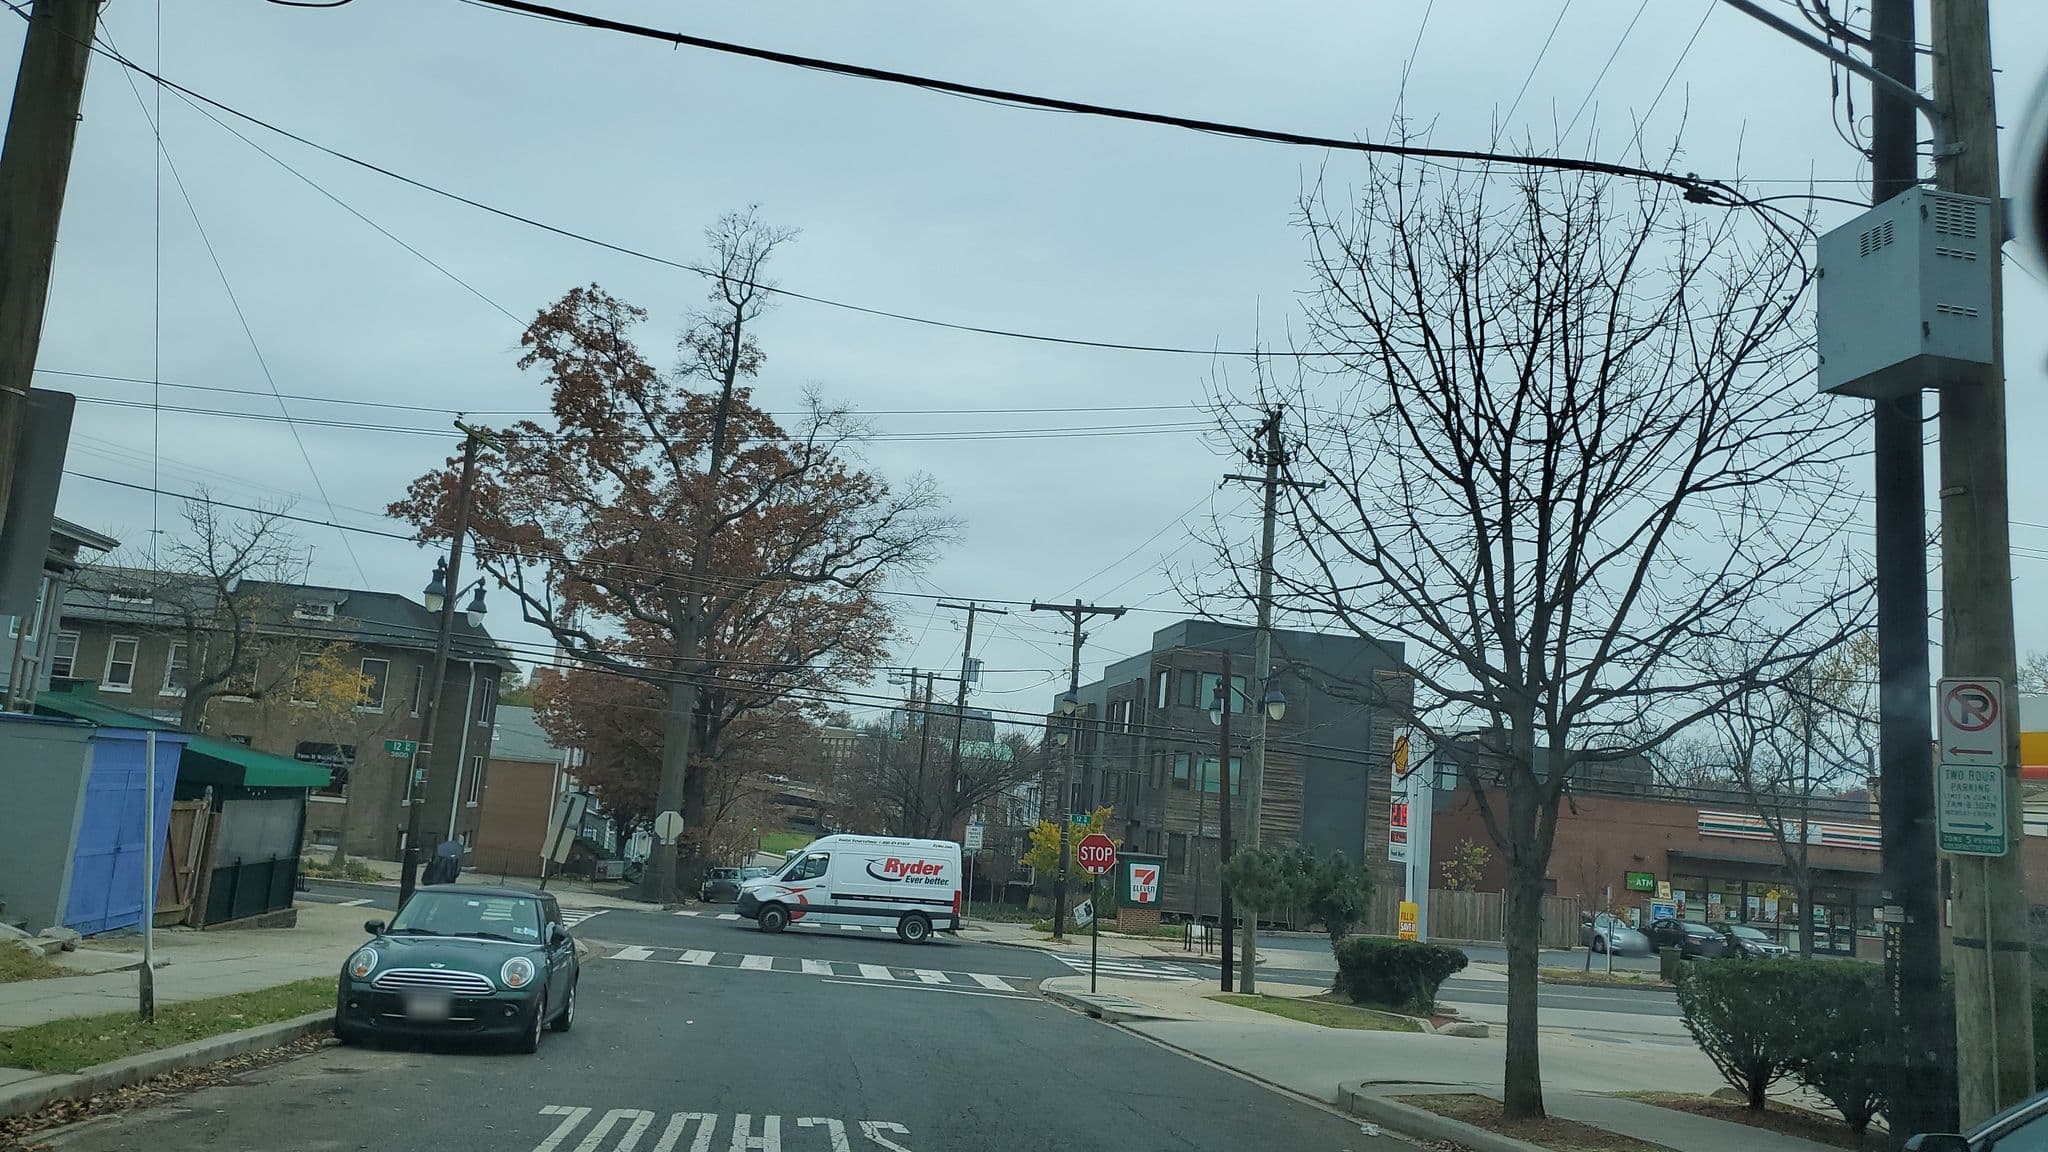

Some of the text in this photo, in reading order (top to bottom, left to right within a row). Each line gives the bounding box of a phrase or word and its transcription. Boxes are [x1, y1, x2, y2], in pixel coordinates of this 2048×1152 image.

[1945, 769, 1996, 782] TWO HOUR
[1951, 782, 1990, 793] PARKING
[1080, 846, 1113, 862] STOP
[883, 857, 944, 877] Ryder
[905, 875, 950, 886] Ever better.
[1636, 879, 1654, 888] ATM
